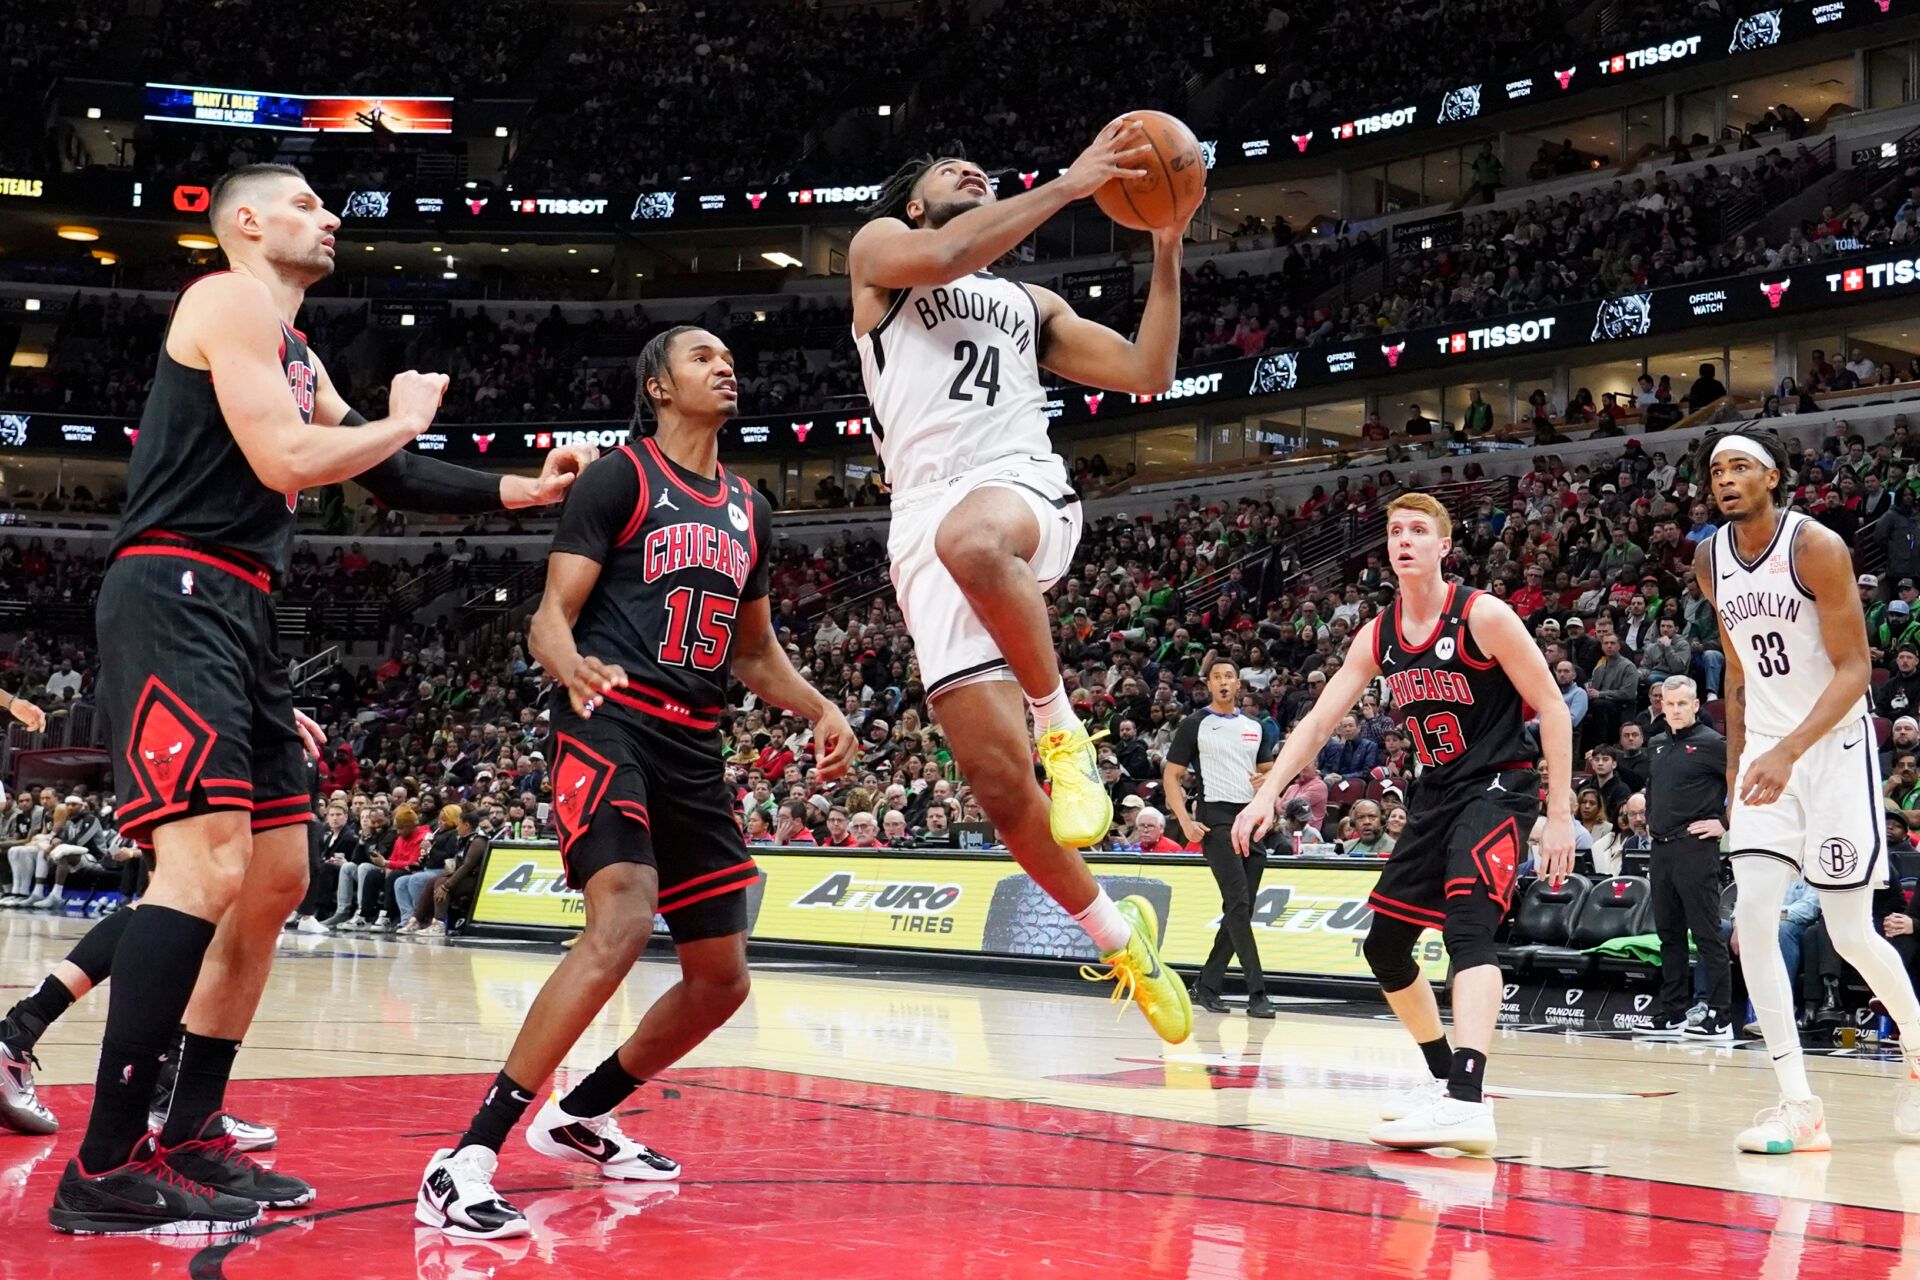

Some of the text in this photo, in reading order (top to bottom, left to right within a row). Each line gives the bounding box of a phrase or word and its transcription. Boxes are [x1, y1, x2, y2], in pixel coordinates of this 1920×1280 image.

[1812, 1, 1845, 16] OFFICIAL
[1815, 12, 1842, 24] WATCH
[1626, 35, 1701, 69] TISSOT
[1506, 78, 1533, 91] OFFICIAL
[193, 92, 222, 107] MARY
[1508, 87, 1531, 99] WATCH
[1354, 107, 1417, 135] TISSOT
[1242, 139, 1270, 150] OFFICIAL
[1245, 147, 1267, 157] WATCH
[536, 199, 608, 214] TISSOT
[1689, 290, 1726, 304] OFFICIAL
[1693, 302, 1723, 316] WATCH
[914, 287, 1031, 355] BROOKLYN
[1468, 317, 1555, 351] TISSOT
[1326, 351, 1357, 364] OFFICIAL
[949, 340, 1001, 407] 24
[1329, 361, 1354, 373] WATCH
[61, 424, 96, 434] OFFICIAL
[740, 426, 770, 434] OFFICIAL
[64, 432, 92, 442] WATCH
[416, 434, 447, 442] OFFICIAL
[552, 430, 630, 447] TISSOT
[743, 434, 767, 442] WATCH
[418, 442, 445, 450] WATCH
[1720, 592, 1801, 631] BROOKLYN
[657, 585, 739, 672] 15
[1751, 631, 1790, 678] 33
[1386, 668, 1474, 709] HICAGO
[1406, 711, 1467, 767] 13
[890, 914, 954, 934] TIRES
[1500, 1003, 1520, 1012] DUEL
[1545, 1007, 1585, 1017] FANDUEL
